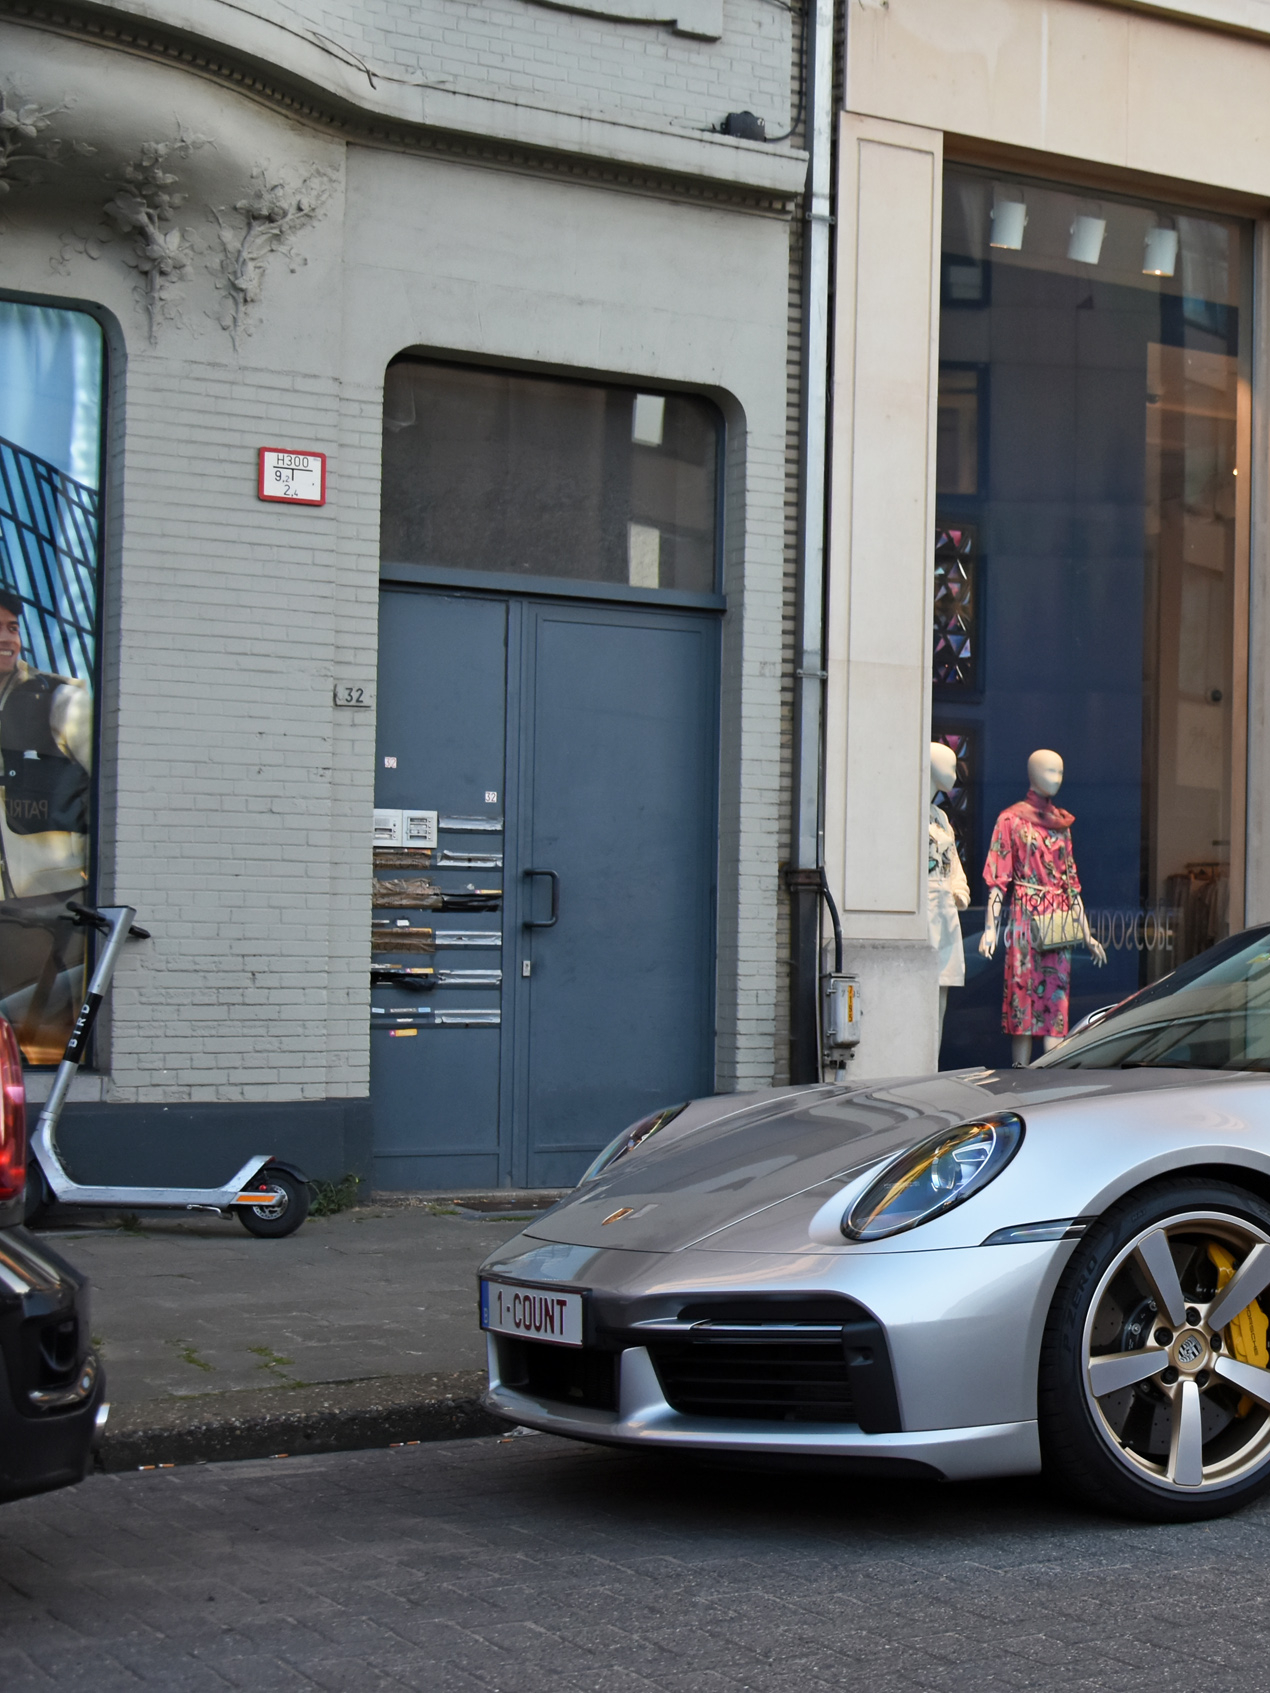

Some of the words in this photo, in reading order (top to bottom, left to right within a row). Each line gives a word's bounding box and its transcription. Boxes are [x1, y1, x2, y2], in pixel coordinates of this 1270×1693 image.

[276, 453, 310, 469] H300
[345, 687, 364, 703] 32
[485, 791, 497, 803] 32
[68, 1003, 91, 1048] BIRD
[497, 1289, 567, 1336] 1-COUNT
